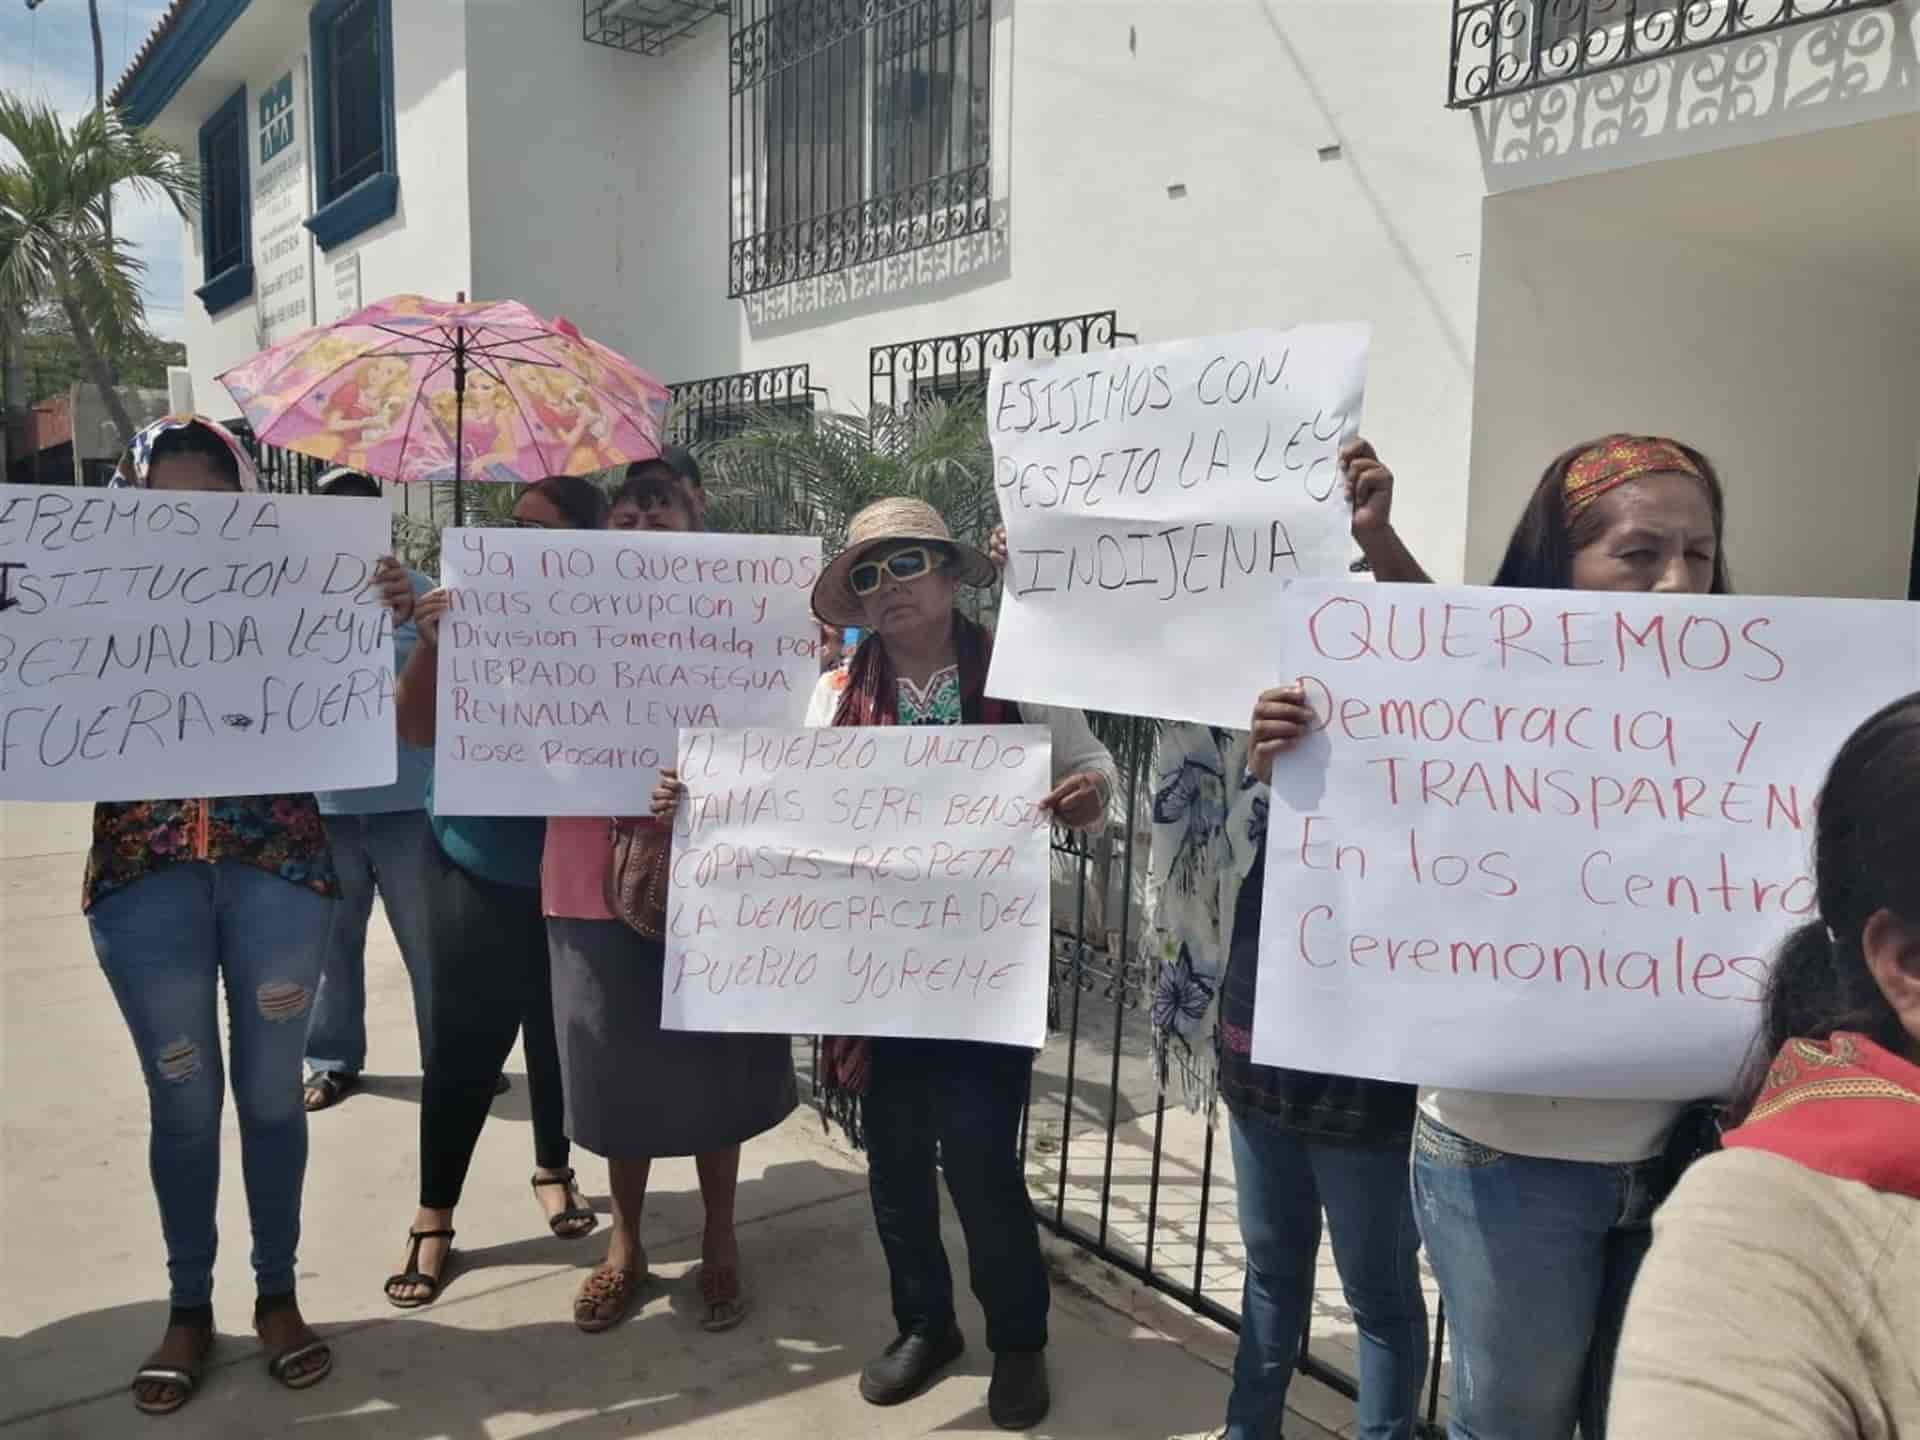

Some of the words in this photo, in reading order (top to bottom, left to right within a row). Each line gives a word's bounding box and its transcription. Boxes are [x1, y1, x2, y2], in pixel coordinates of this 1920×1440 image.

[1179, 430, 1230, 489] LA
[219, 498, 280, 540] LA
[541, 548, 595, 579] no
[615, 547, 818, 591] Queremos
[1018, 520, 1299, 601] INDIJENA
[448, 587, 532, 616] mas
[452, 622, 577, 648] Division
[586, 624, 754, 659] Fomentada
[1309, 596, 1785, 682] QUEREMOS
[451, 656, 596, 688] LIBRADO
[614, 661, 793, 693] BACASEGUA
[1, 689, 215, 772] FUERA
[261, 666, 396, 736] FUERA
[454, 687, 611, 728] REYNALDA
[626, 700, 721, 728] LEYVA
[1294, 674, 1677, 767] Democracia
[450, 735, 527, 765] Jose
[540, 738, 659, 769] Rosario
[680, 734, 721, 782] EL
[738, 729, 878, 776] PUEBLO
[902, 733, 1026, 770] UNIDO
[675, 784, 804, 839] JAMAS
[828, 785, 922, 831] SERA
[845, 841, 1016, 882] RESPETA
[1301, 815, 1366, 880] En
[669, 903, 719, 938] LA
[736, 893, 962, 933] DEMOCRACIA
[979, 891, 1042, 932] DEL
[672, 944, 817, 995] PUEBLO
[1299, 904, 1775, 1003] Ceremoniales
